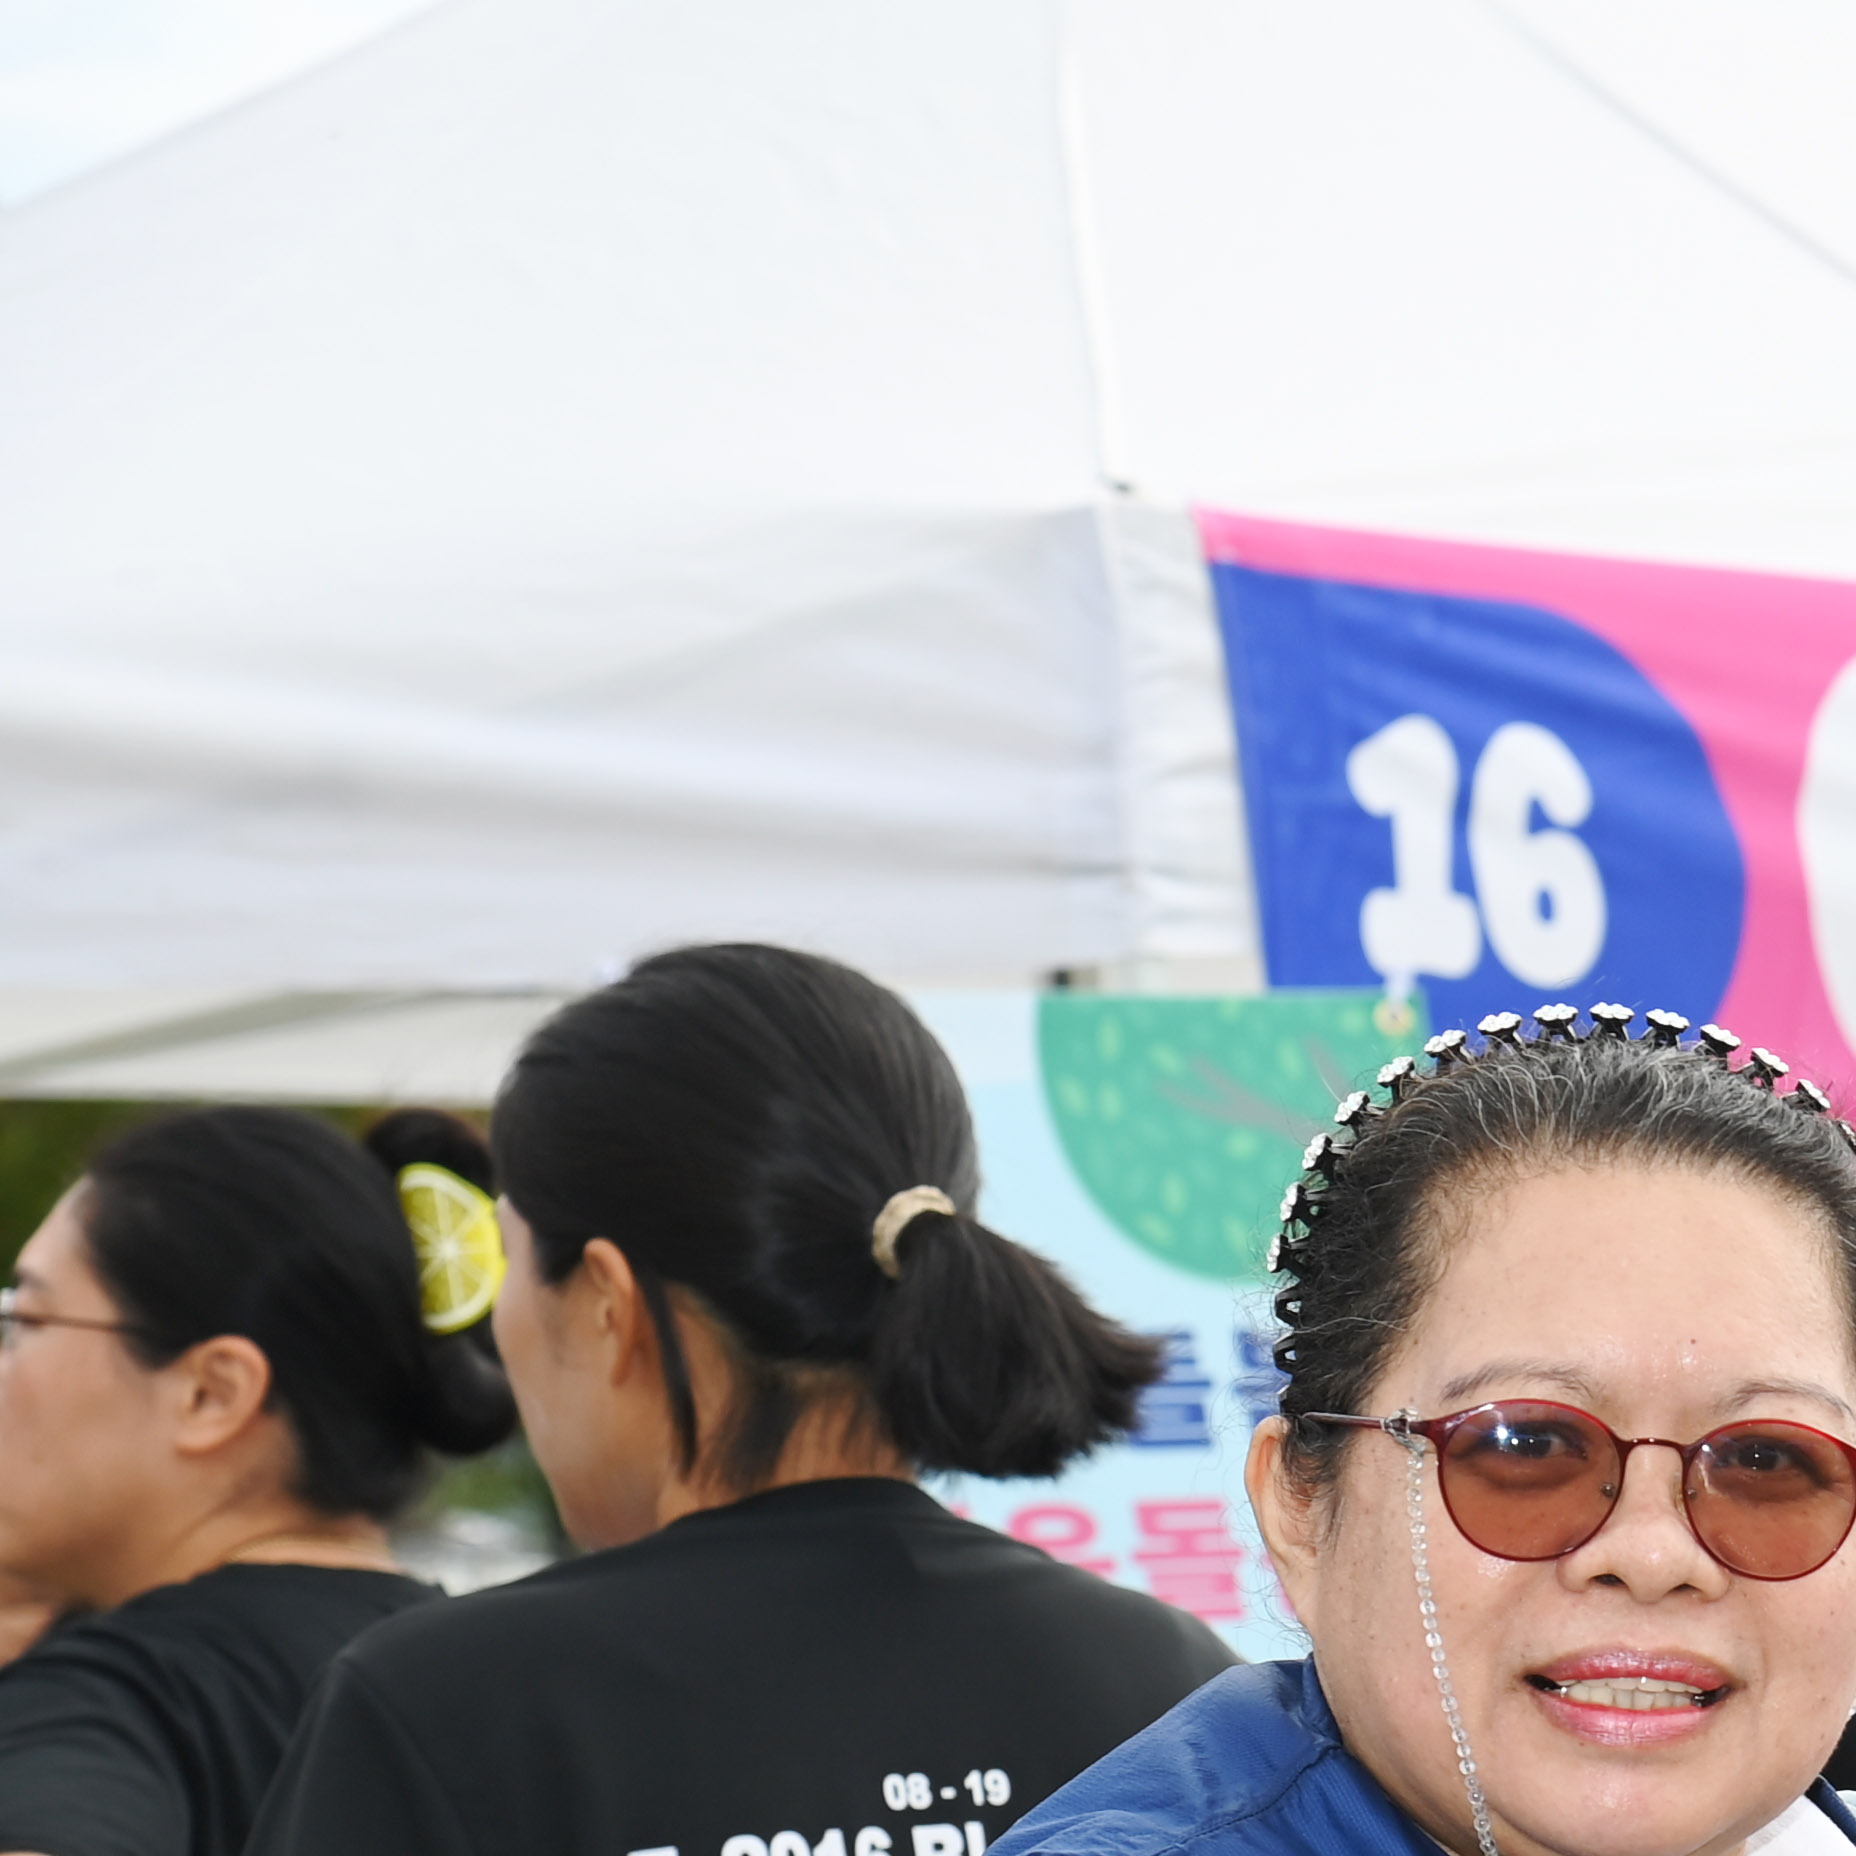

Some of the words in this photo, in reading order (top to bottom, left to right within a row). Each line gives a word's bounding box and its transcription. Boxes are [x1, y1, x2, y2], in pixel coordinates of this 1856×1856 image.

[1347, 713, 1607, 990] 16
[882, 1772, 933, 1811] 08
[964, 1768, 1011, 1806] 19
